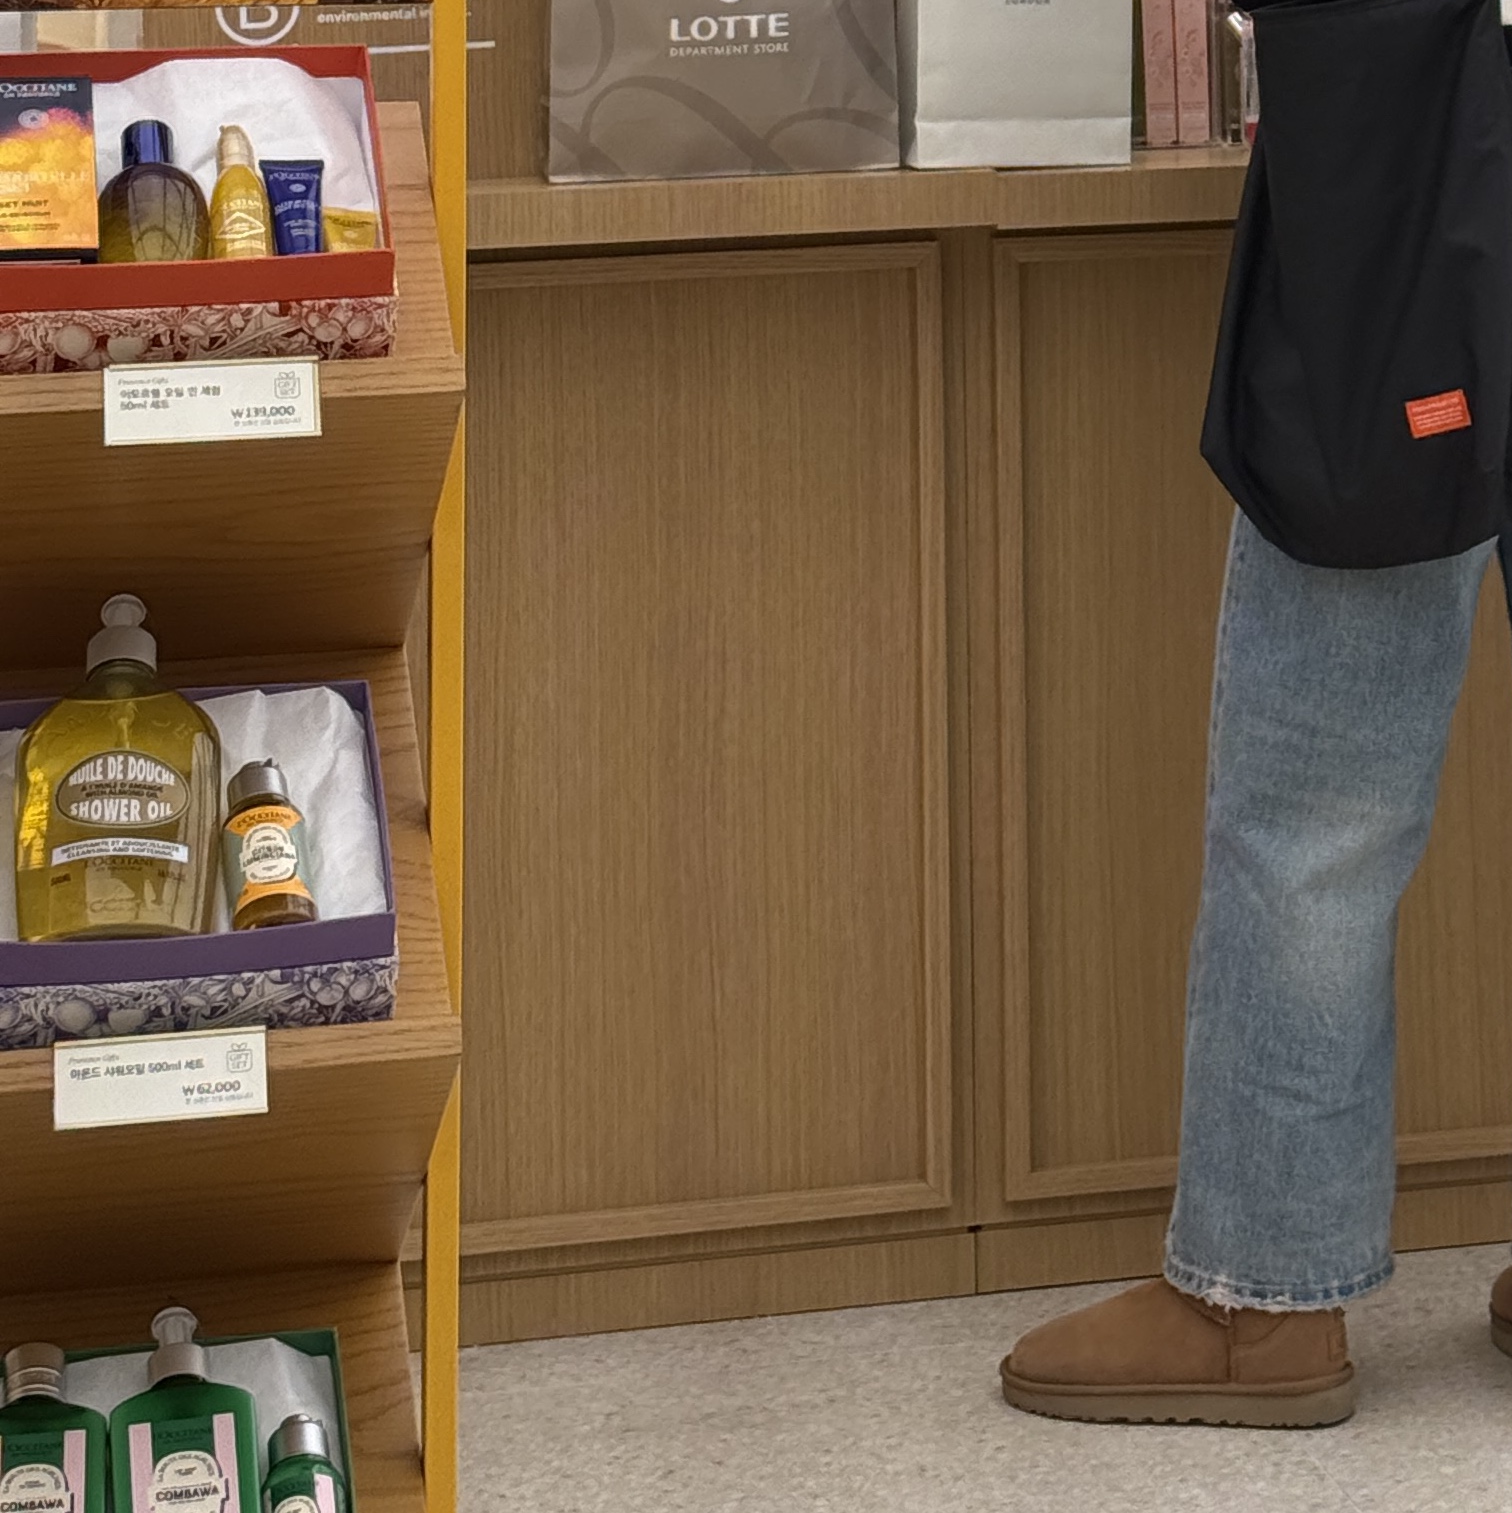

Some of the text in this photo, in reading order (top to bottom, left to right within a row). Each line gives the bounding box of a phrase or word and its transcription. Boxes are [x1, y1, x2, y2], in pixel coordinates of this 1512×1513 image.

[316, 8, 417, 24] environmental
[669, 12, 790, 42] LOTTE
[669, 42, 790, 57] DEPARTMENT STORE
[0, 82, 78, 93] OCCITANE
[68, 755, 176, 787] HUILE DE DOUCHE
[69, 798, 173, 822] SHOWER OIL
[155, 1485, 220, 1502] COMBAWA
[0, 1498, 65, 1512] COMBAWA
